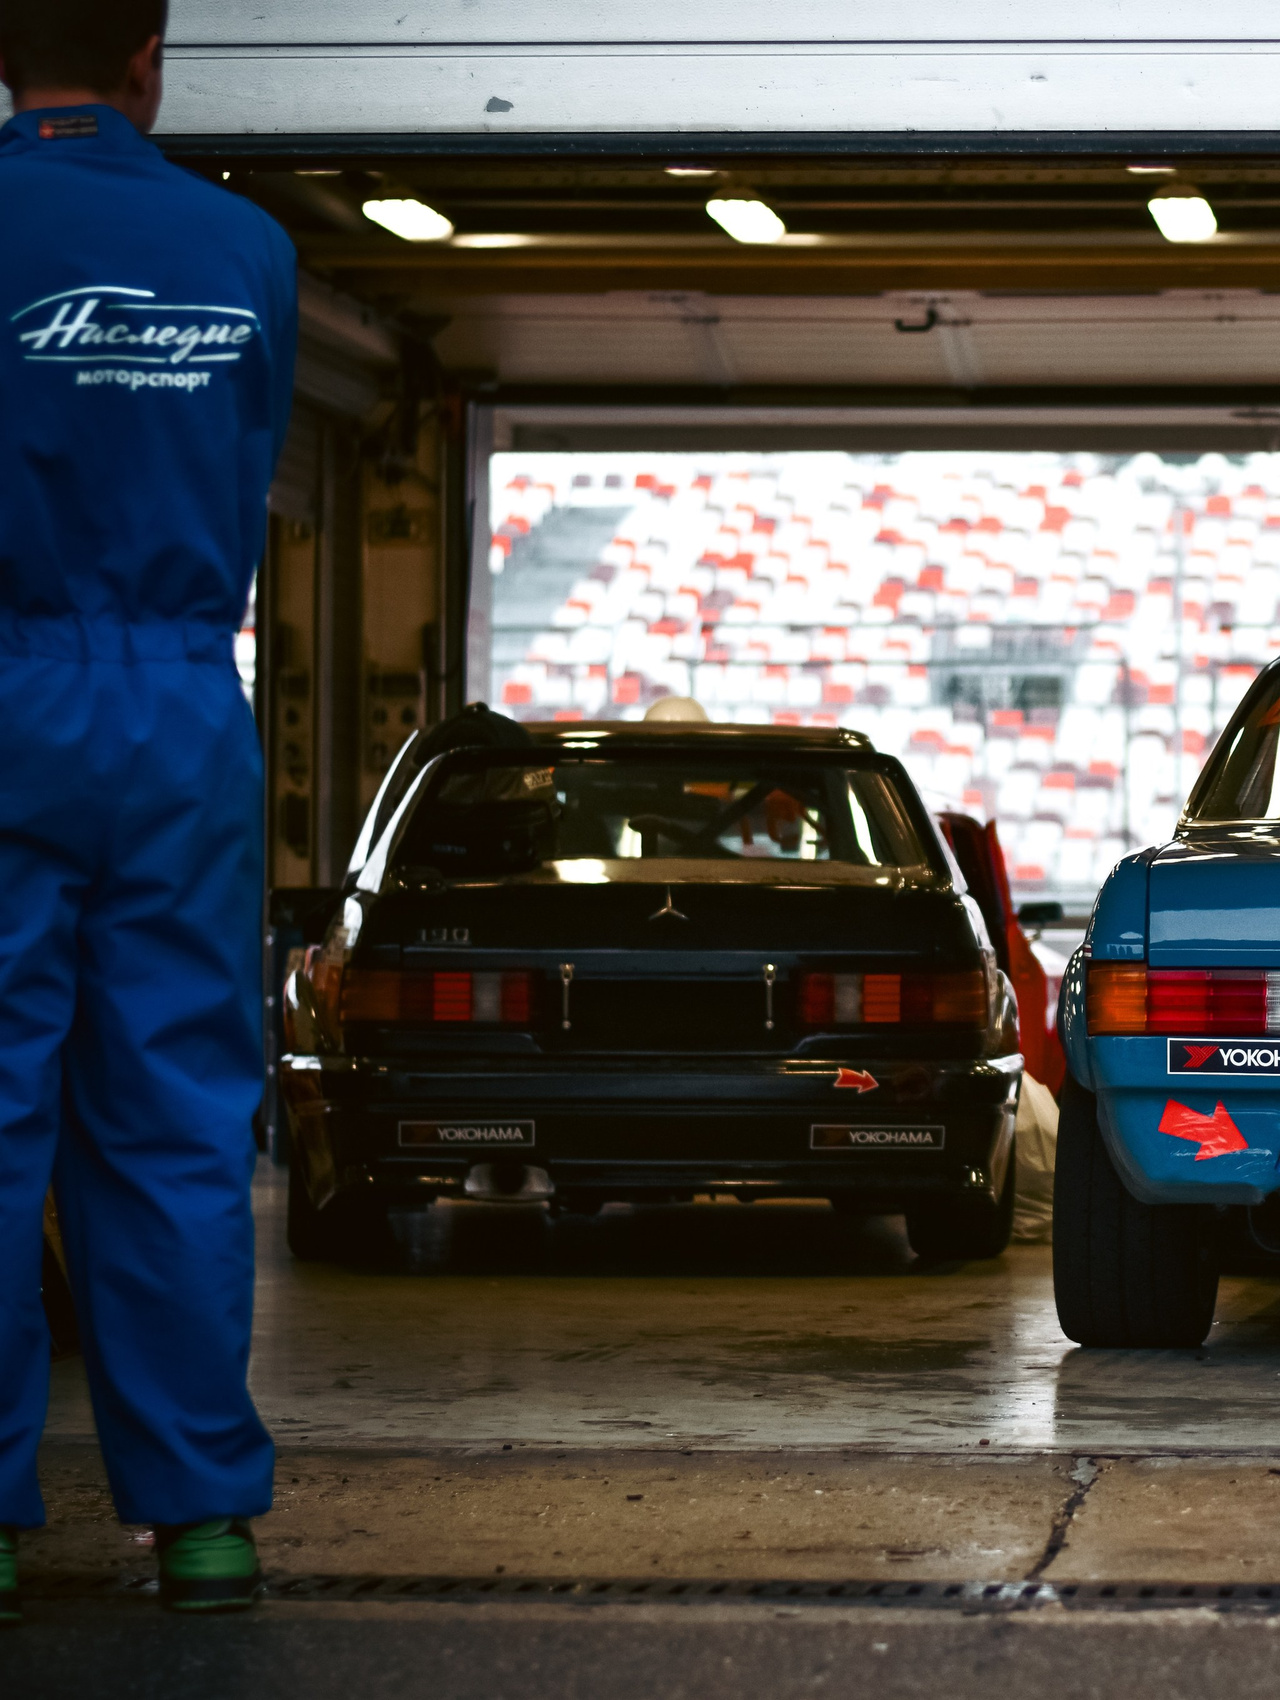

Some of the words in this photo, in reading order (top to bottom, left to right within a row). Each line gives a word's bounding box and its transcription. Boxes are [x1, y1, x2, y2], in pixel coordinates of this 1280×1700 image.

[19, 299, 253, 364] Наследие
[76, 369, 212, 393] моторспорт
[438, 1127, 524, 1141] YOKOHAMA
[850, 1131, 934, 1144] YOKOHAMA
